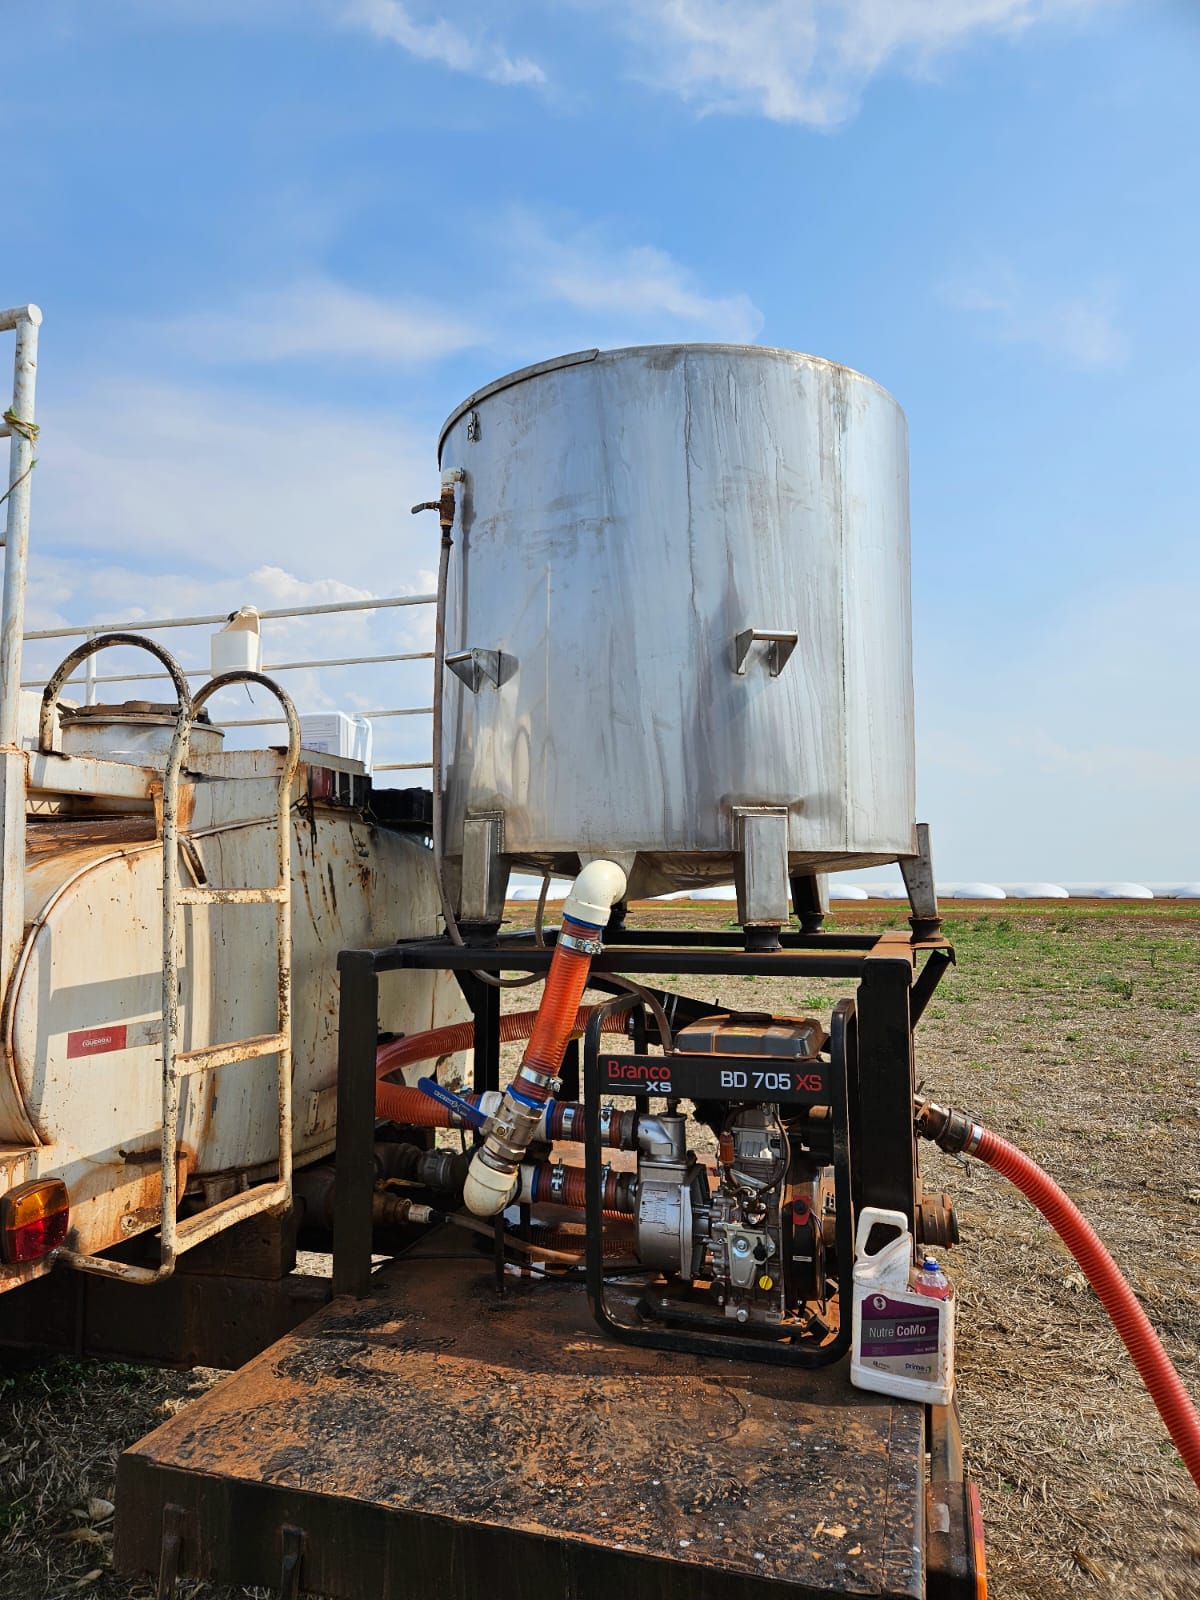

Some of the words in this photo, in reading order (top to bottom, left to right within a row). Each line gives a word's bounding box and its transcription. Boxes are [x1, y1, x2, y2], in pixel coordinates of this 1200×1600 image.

[608, 1060, 671, 1079] Branco
[645, 1081, 672, 1092] XS
[720, 1070, 748, 1088] BD
[751, 1072, 791, 1090] 705
[795, 1074, 823, 1091] XS
[869, 1327, 895, 1338] Nutre
[896, 1324, 926, 1337] CoMo
